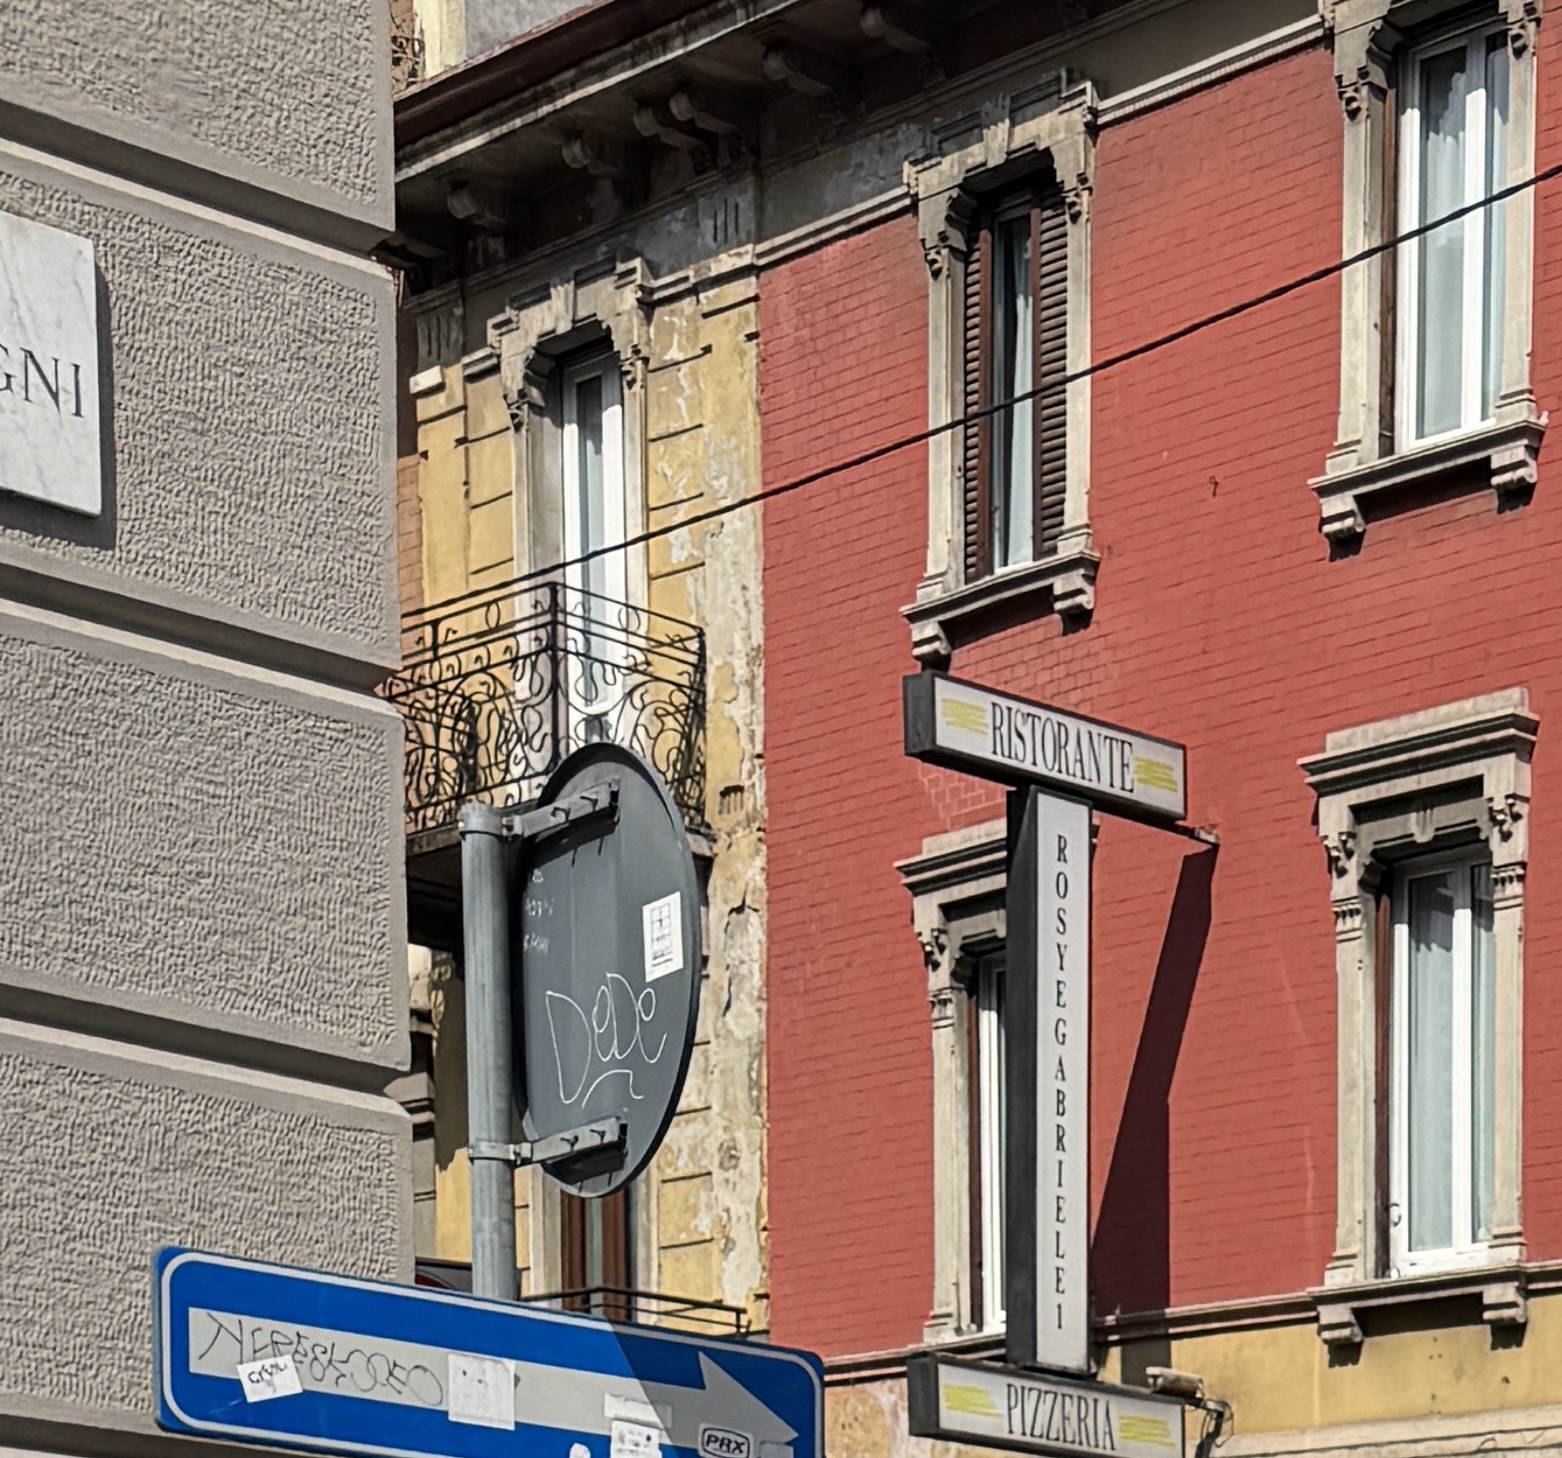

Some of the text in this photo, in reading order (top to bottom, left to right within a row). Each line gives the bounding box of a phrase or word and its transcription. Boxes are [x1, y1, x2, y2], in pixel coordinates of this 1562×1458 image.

[991, 702, 1135, 793] RISTORANTE
[706, 1434, 746, 1454] PRX
[1006, 1383, 1116, 1450] PIZZERIA
